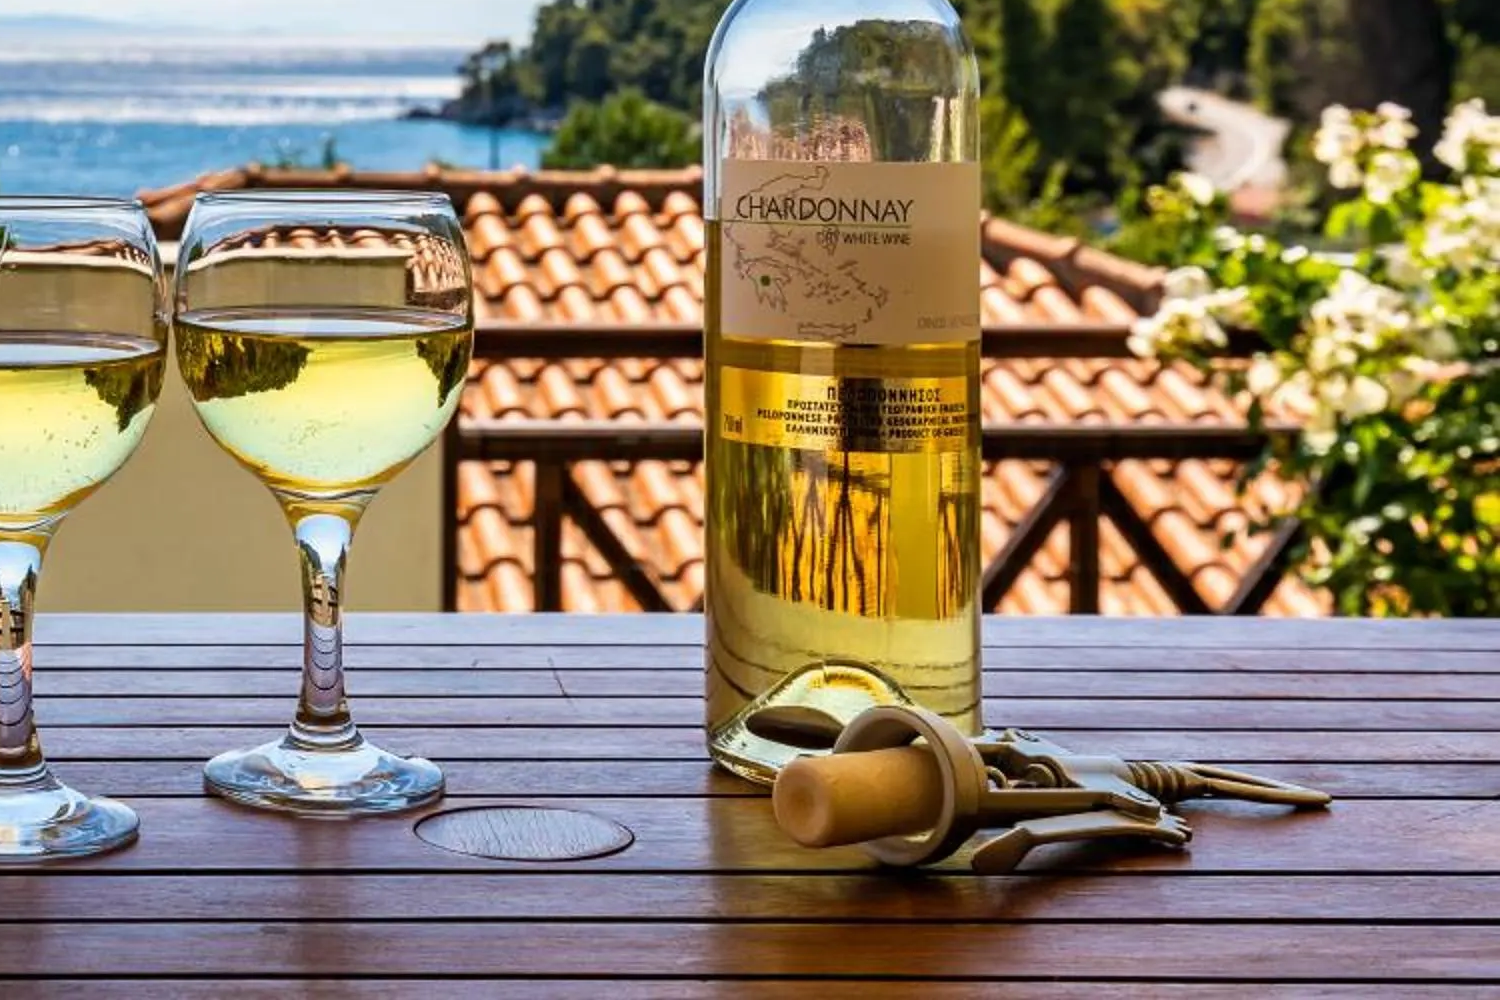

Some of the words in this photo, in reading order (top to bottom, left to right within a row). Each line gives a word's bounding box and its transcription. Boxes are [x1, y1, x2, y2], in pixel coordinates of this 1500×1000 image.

[736, 195, 914, 223] CHARDONNAY
[843, 231, 880, 245] WHITE
[882, 231, 911, 245] WINE
